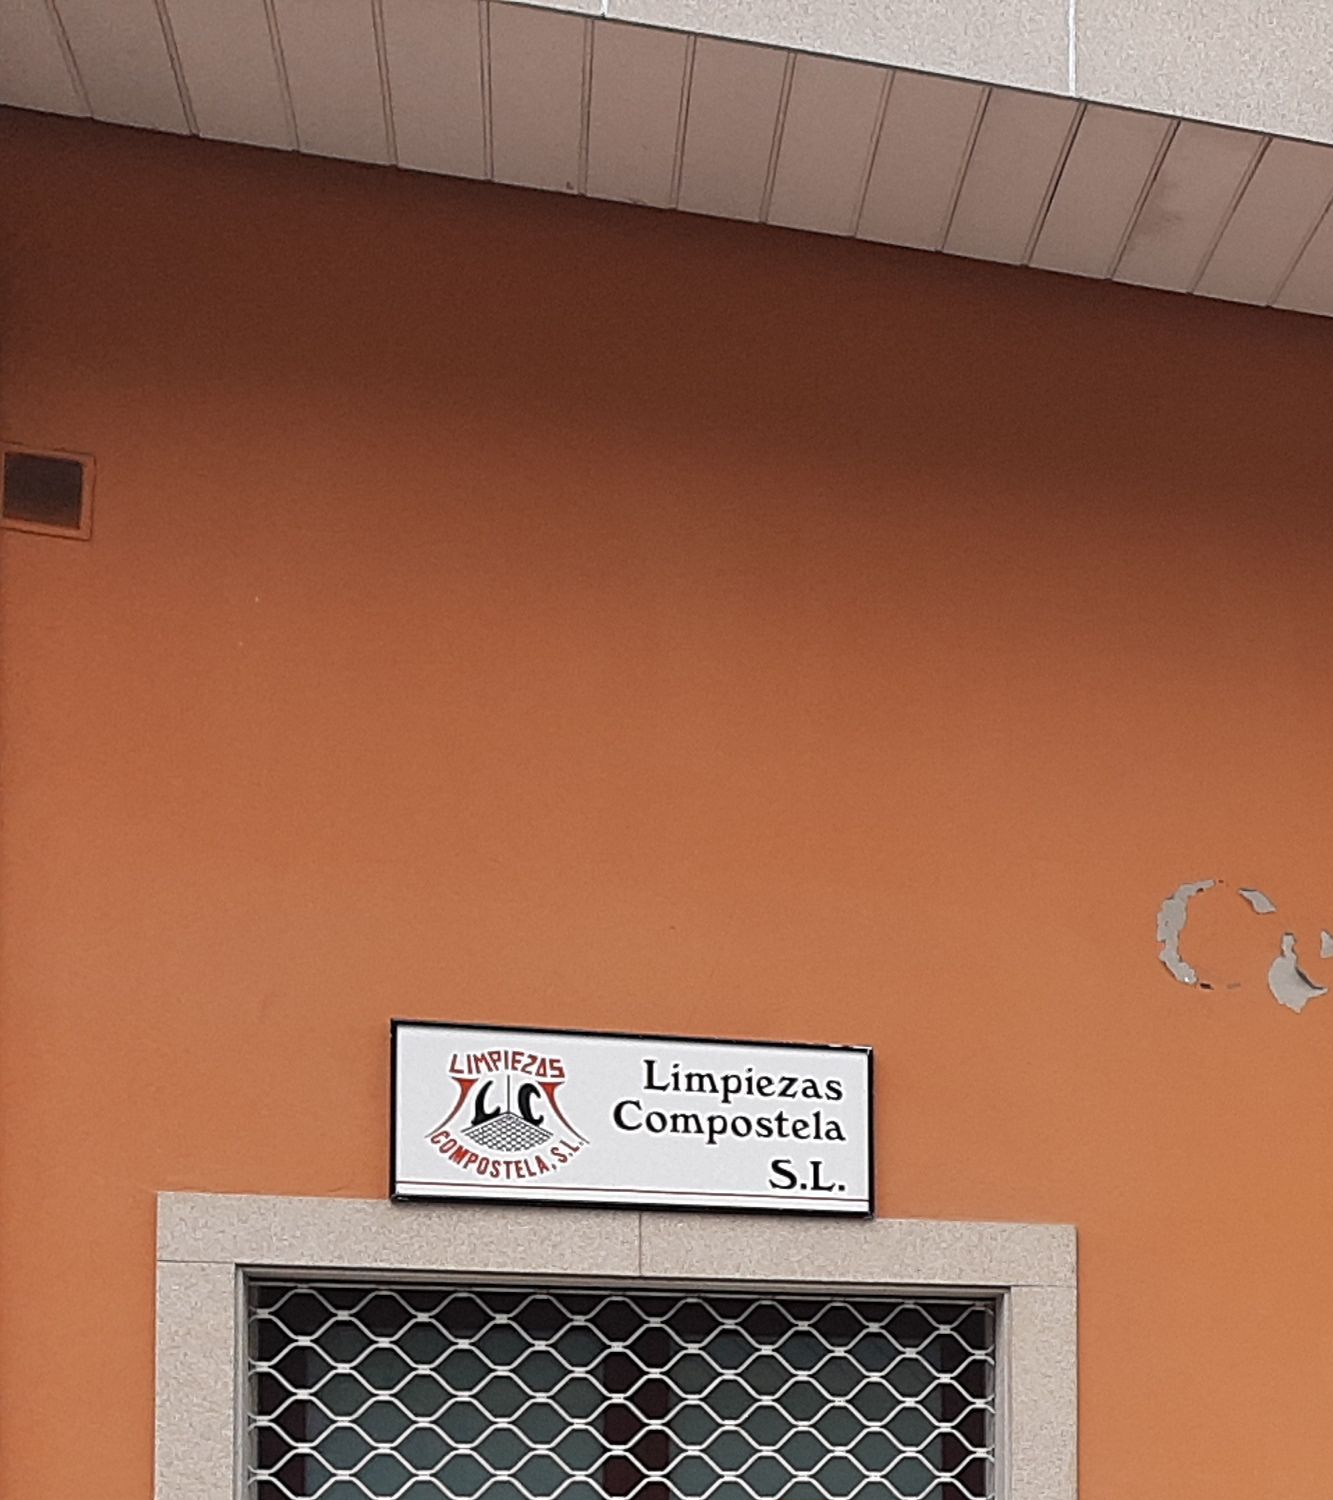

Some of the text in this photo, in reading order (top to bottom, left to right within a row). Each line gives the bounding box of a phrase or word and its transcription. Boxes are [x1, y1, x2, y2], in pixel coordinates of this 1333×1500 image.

[449, 1050, 566, 1079] LIMPIEZAS
[643, 1059, 844, 1103] Limpiezas
[613, 1100, 846, 1143] Compostela
[768, 1159, 846, 1192] S.L.
